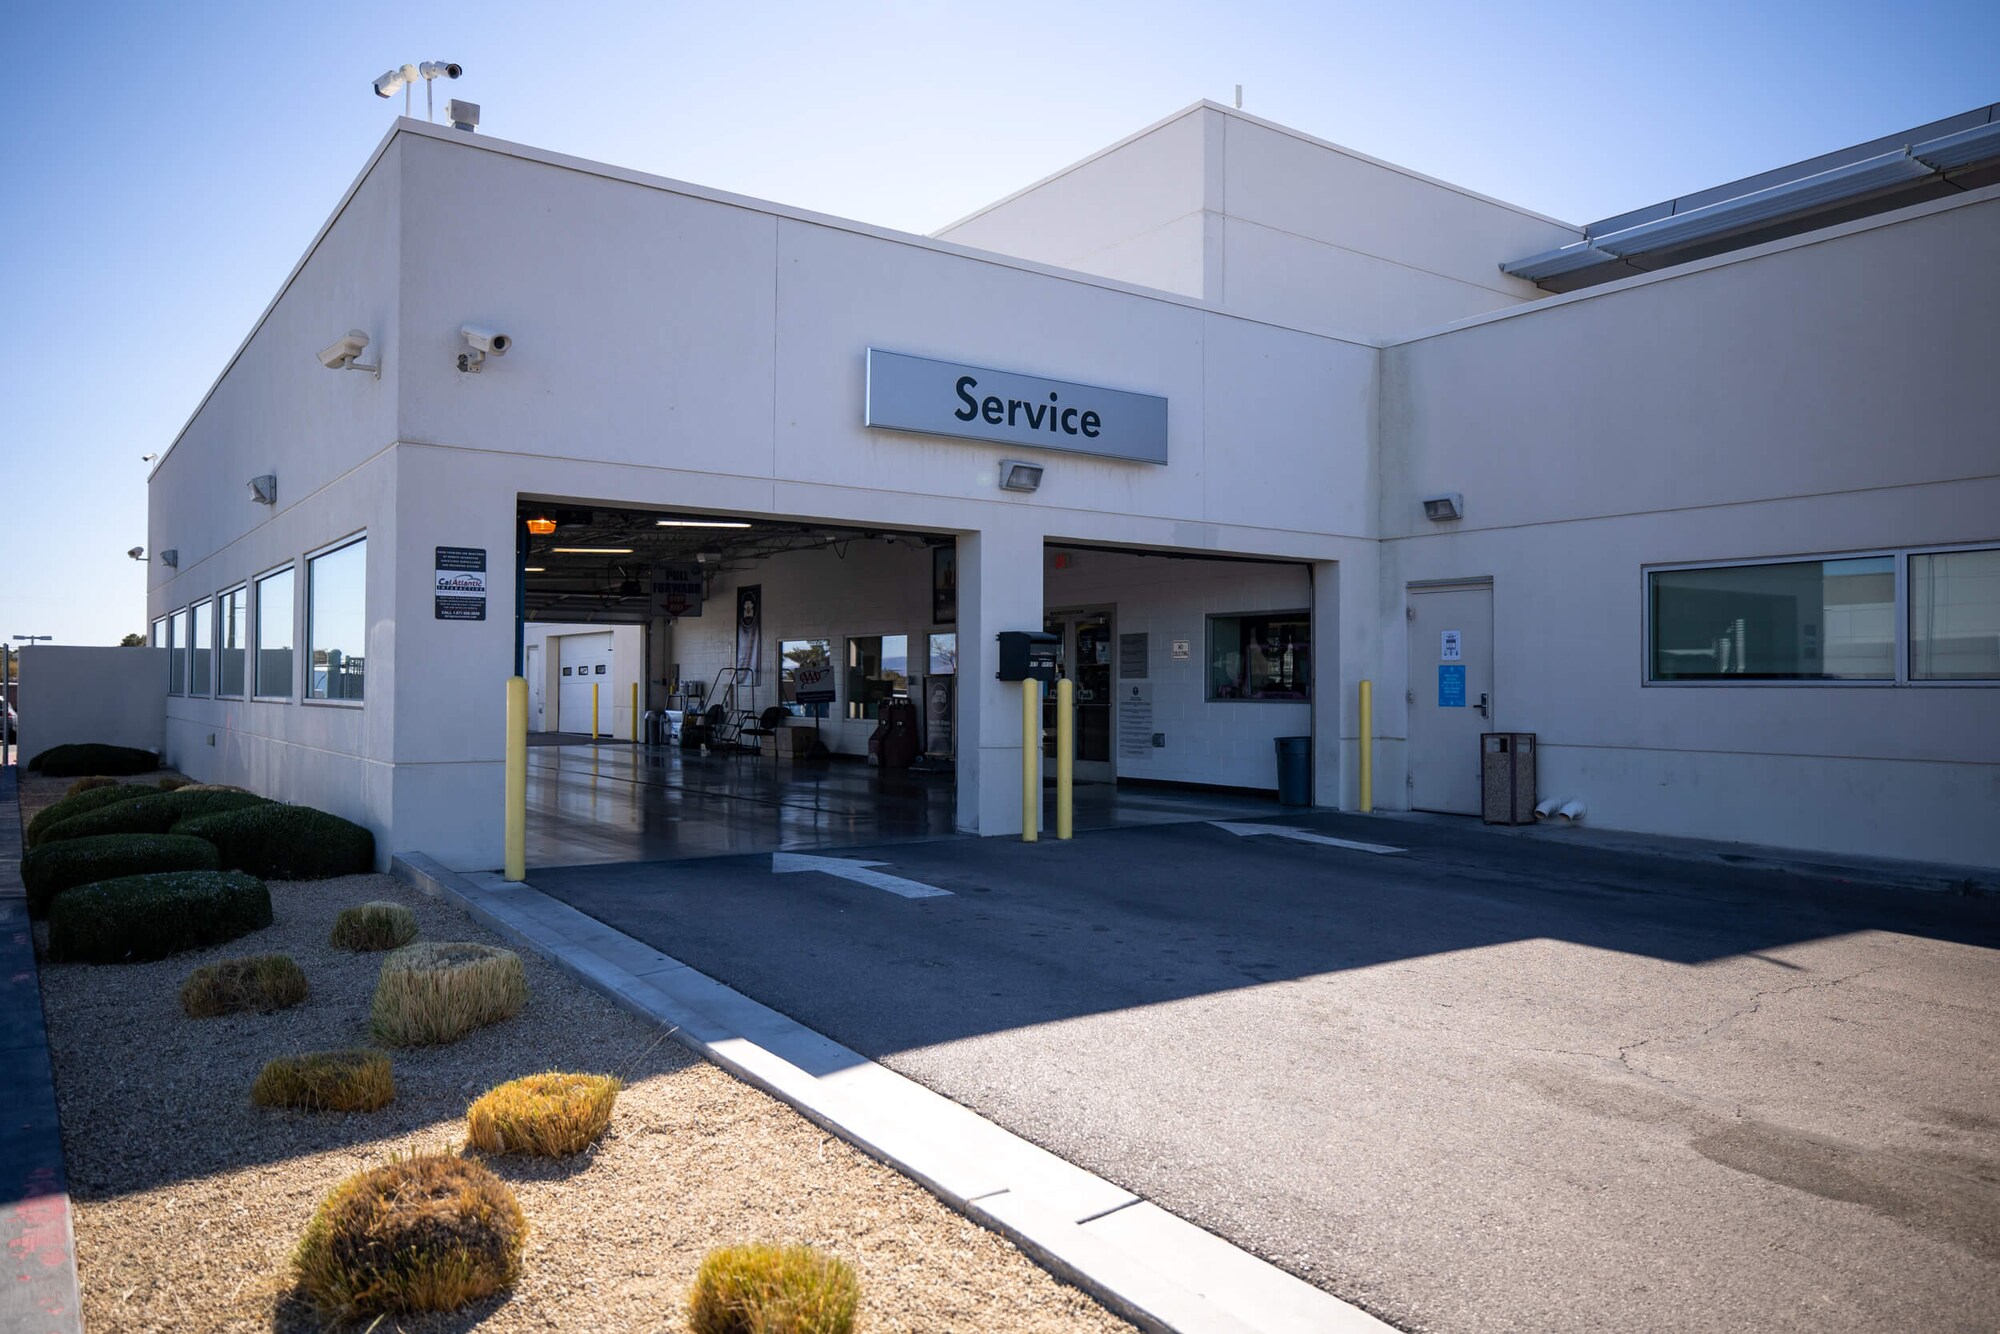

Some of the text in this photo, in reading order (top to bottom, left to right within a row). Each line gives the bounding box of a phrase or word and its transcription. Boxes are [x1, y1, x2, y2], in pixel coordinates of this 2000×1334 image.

[954, 376, 1101, 438] Service
[666, 570, 688, 581] PULL
[438, 578, 482, 587] CalAtlantic
[652, 582, 701, 594] FORWARD
